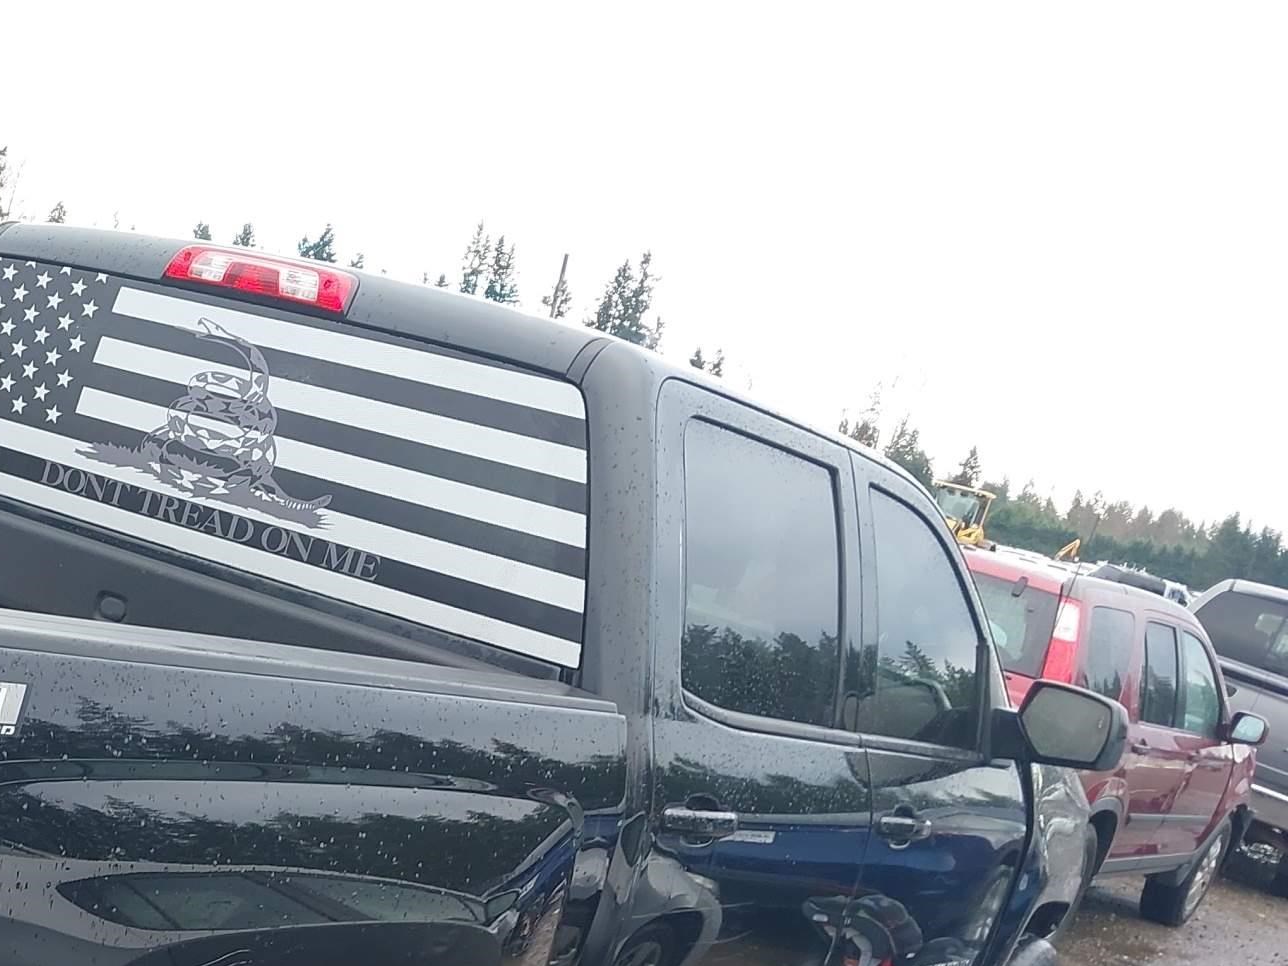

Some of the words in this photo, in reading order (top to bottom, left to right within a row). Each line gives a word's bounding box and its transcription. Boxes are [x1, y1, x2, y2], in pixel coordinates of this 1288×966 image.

[40, 461, 132, 506] DONT
[138, 489, 254, 542] TREAD
[262, 526, 316, 562] ON
[321, 543, 382, 582] ME
